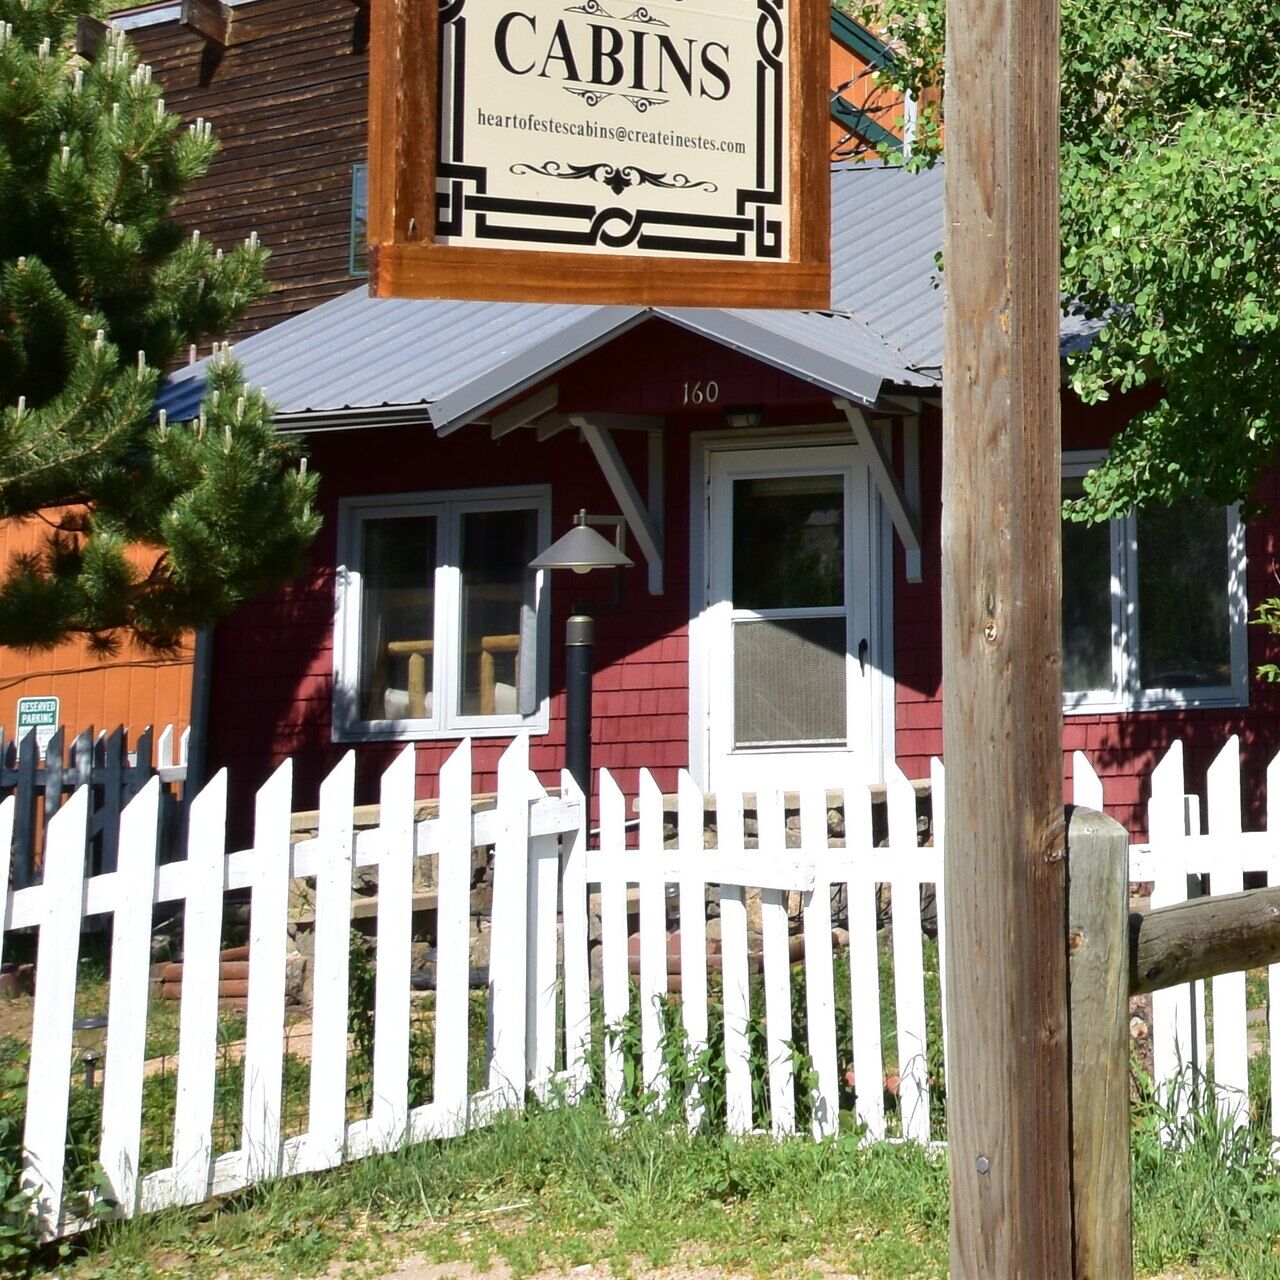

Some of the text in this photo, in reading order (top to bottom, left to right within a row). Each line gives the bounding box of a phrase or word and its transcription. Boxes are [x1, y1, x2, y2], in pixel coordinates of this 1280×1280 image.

[494, 11, 732, 102] CABINS
[477, 107, 747, 155] heartofestescabins@createinestes.com
[683, 380, 719, 405] 160
[20, 701, 56, 713] RESERVED
[22, 713, 54, 724] PARKING
